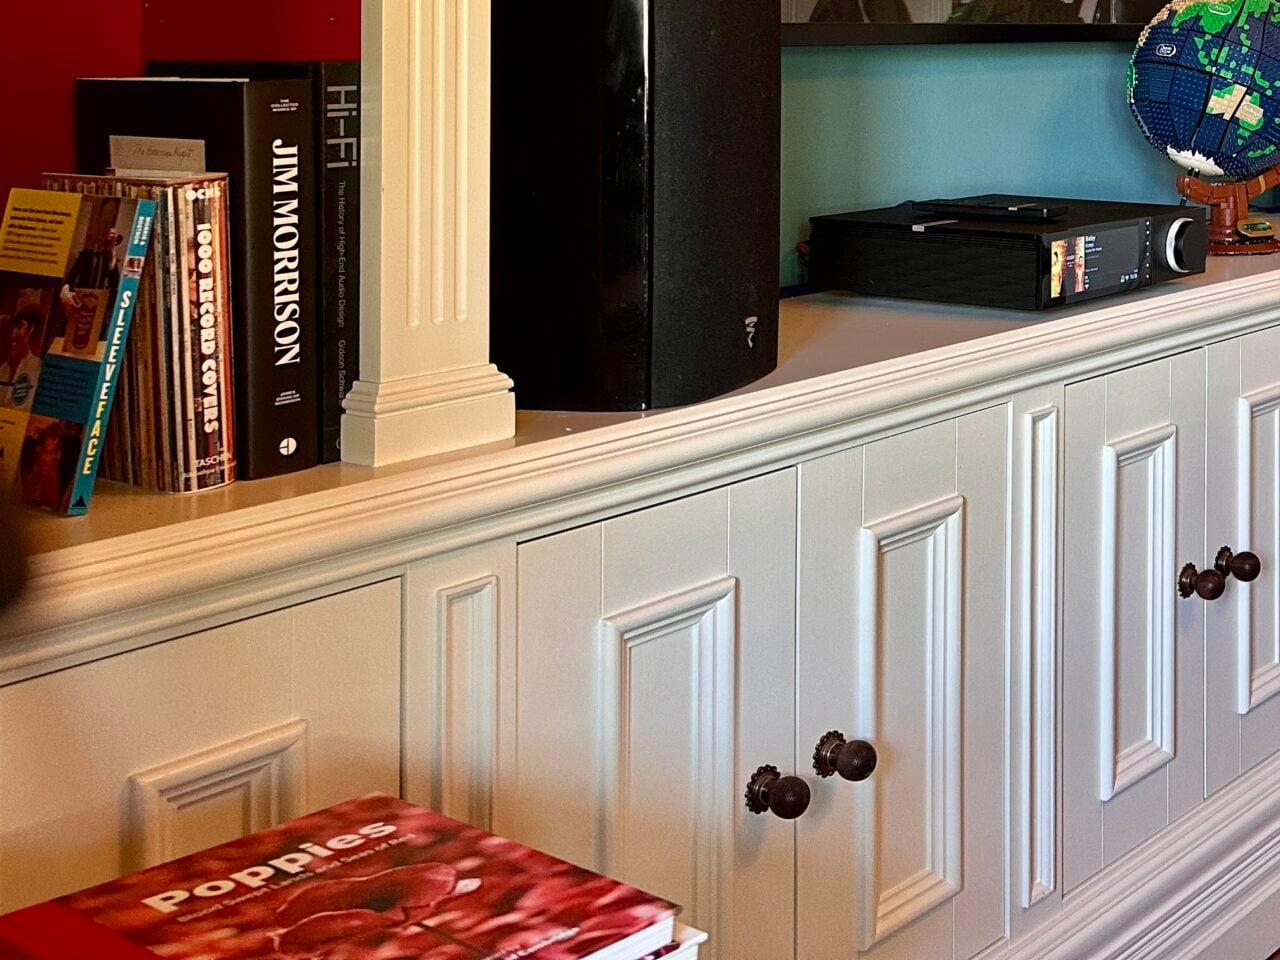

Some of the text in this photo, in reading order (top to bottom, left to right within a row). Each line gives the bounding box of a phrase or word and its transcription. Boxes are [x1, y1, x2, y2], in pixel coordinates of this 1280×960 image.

[326, 85, 358, 169] Hi-Fi
[272, 138, 301, 367] JIM MORRISON
[336, 197, 346, 328] History Audio Design
[196, 223, 220, 435] 1000 RECORD COVERS
[140, 821, 398, 914] Poppies
